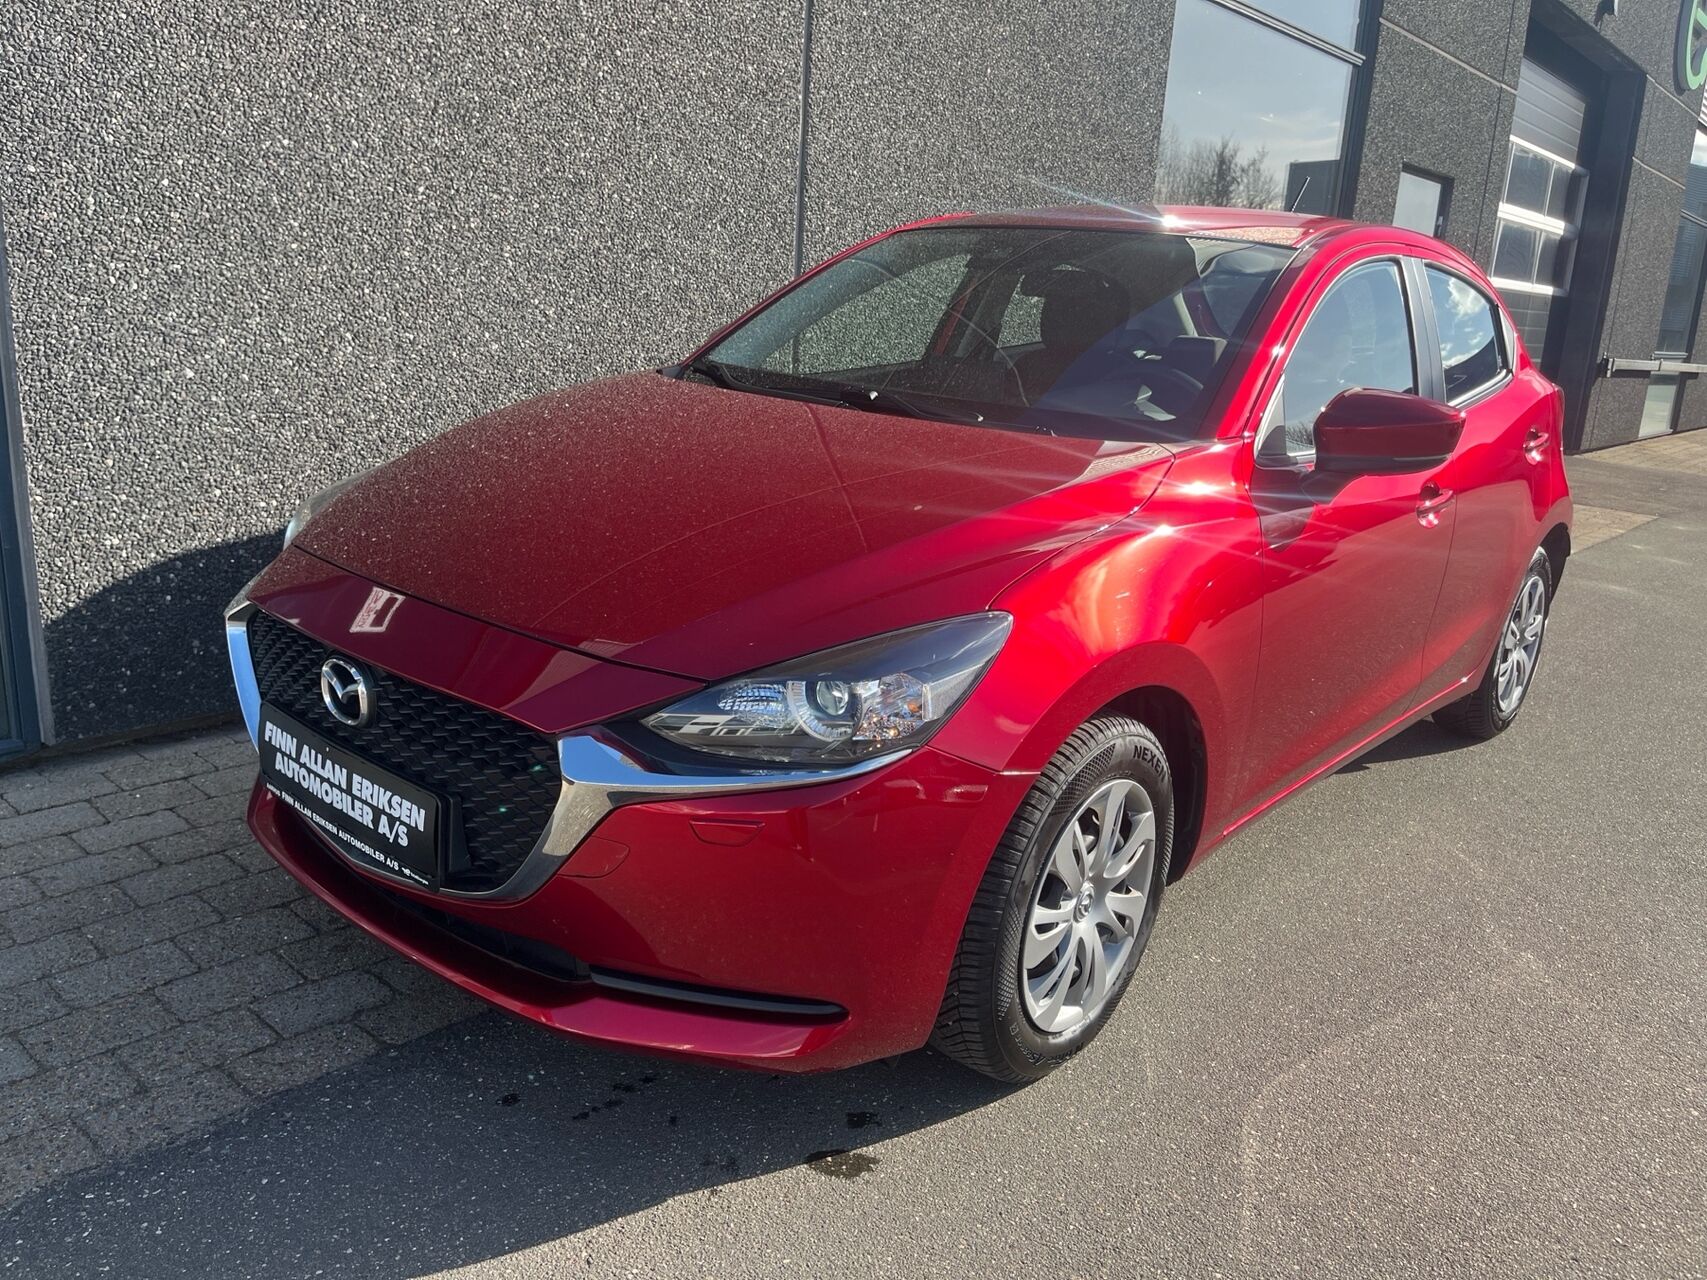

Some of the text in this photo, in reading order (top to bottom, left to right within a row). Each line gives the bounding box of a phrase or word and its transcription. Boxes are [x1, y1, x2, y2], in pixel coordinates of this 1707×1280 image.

[264, 720, 426, 832] FINN ALLAN ERIKSEN
[275, 752, 409, 847] AUTOMOBILER A/S
[1133, 744, 1167, 783] NEXEN
[294, 800, 312, 818] ALLAN
[312, 812, 338, 835] ERIKSEN
[338, 829, 385, 863] AUTOMOBILER
[386, 857, 399, 871] A/S
